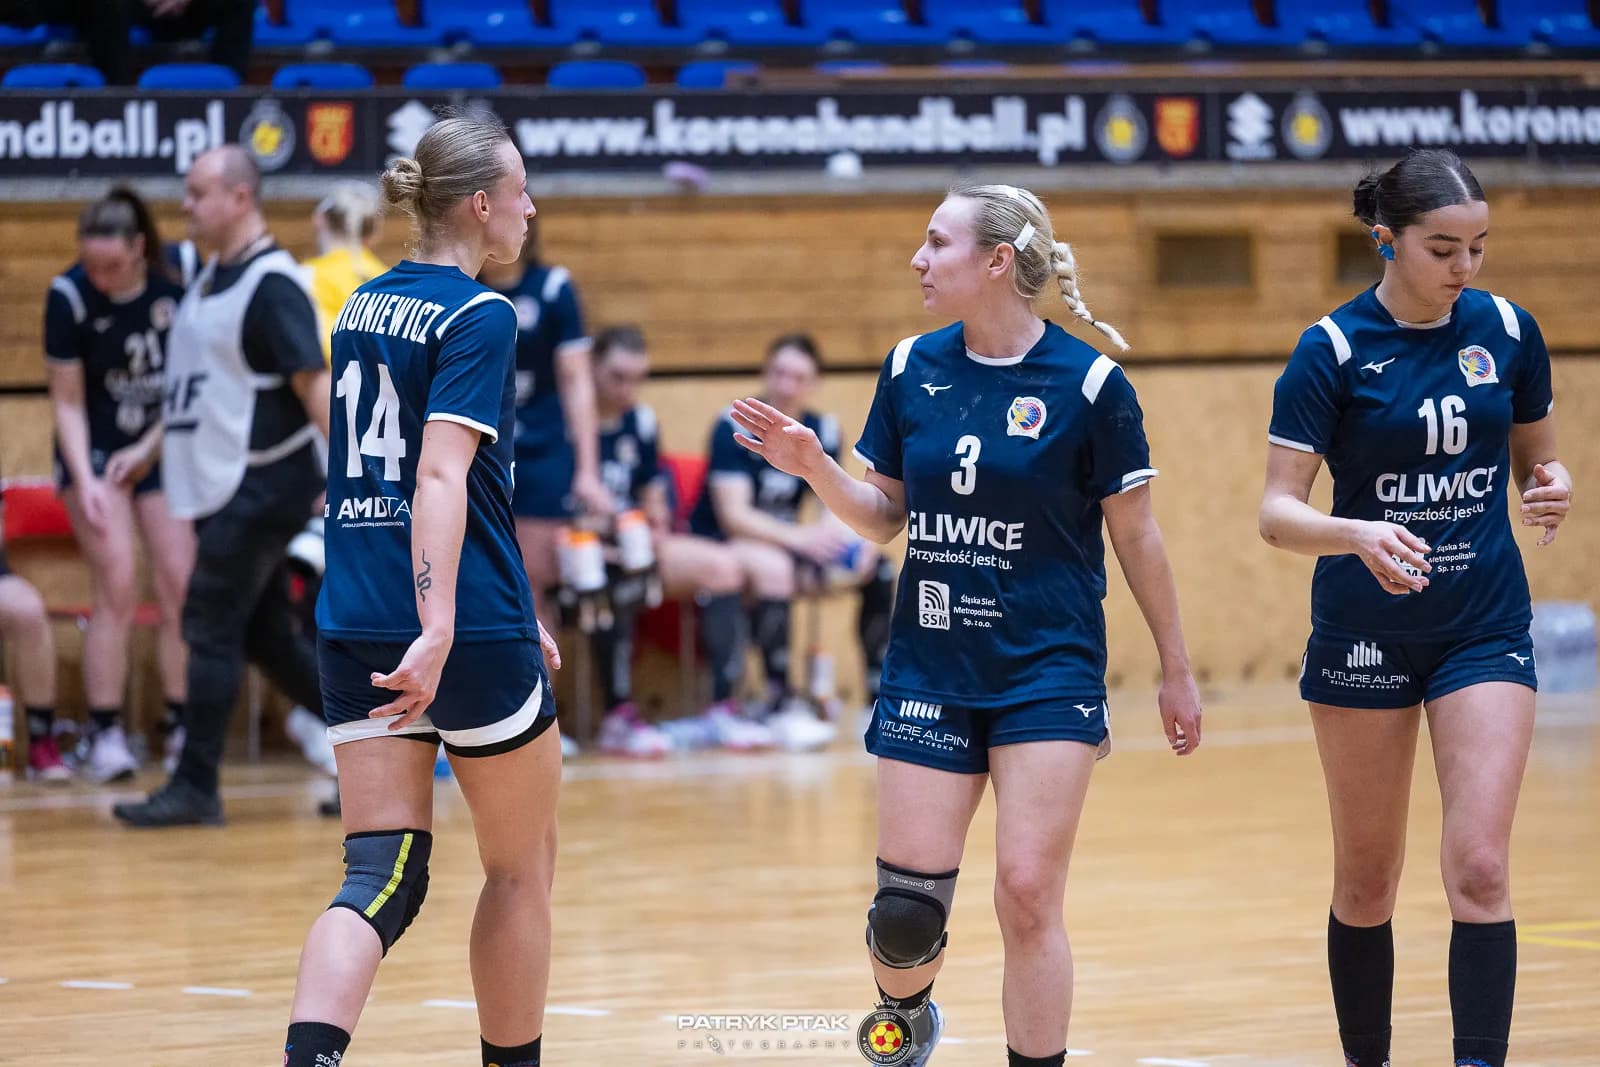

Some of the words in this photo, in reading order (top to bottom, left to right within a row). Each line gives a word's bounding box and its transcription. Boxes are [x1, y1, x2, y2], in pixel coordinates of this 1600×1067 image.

[515, 97, 1086, 166] www.koronahandball.pl
[336, 360, 406, 481] 14
[1417, 394, 1468, 455] 16
[951, 434, 982, 495] 3
[1384, 506, 1451, 523] Przyszłość
[909, 547, 972, 564] Przyszłość
[971, 552, 997, 567] jest
[1437, 565, 1449, 574] Sp.
[960, 594, 981, 605] Śląska
[981, 598, 996, 606] Sieć
[922, 613, 949, 628] SSM
[953, 606, 1003, 618] Metropolitalna
[1321, 668, 1371, 684] FUTURE
[1372, 674, 1410, 684] ALPIN
[923, 730, 969, 748] ALPIN
